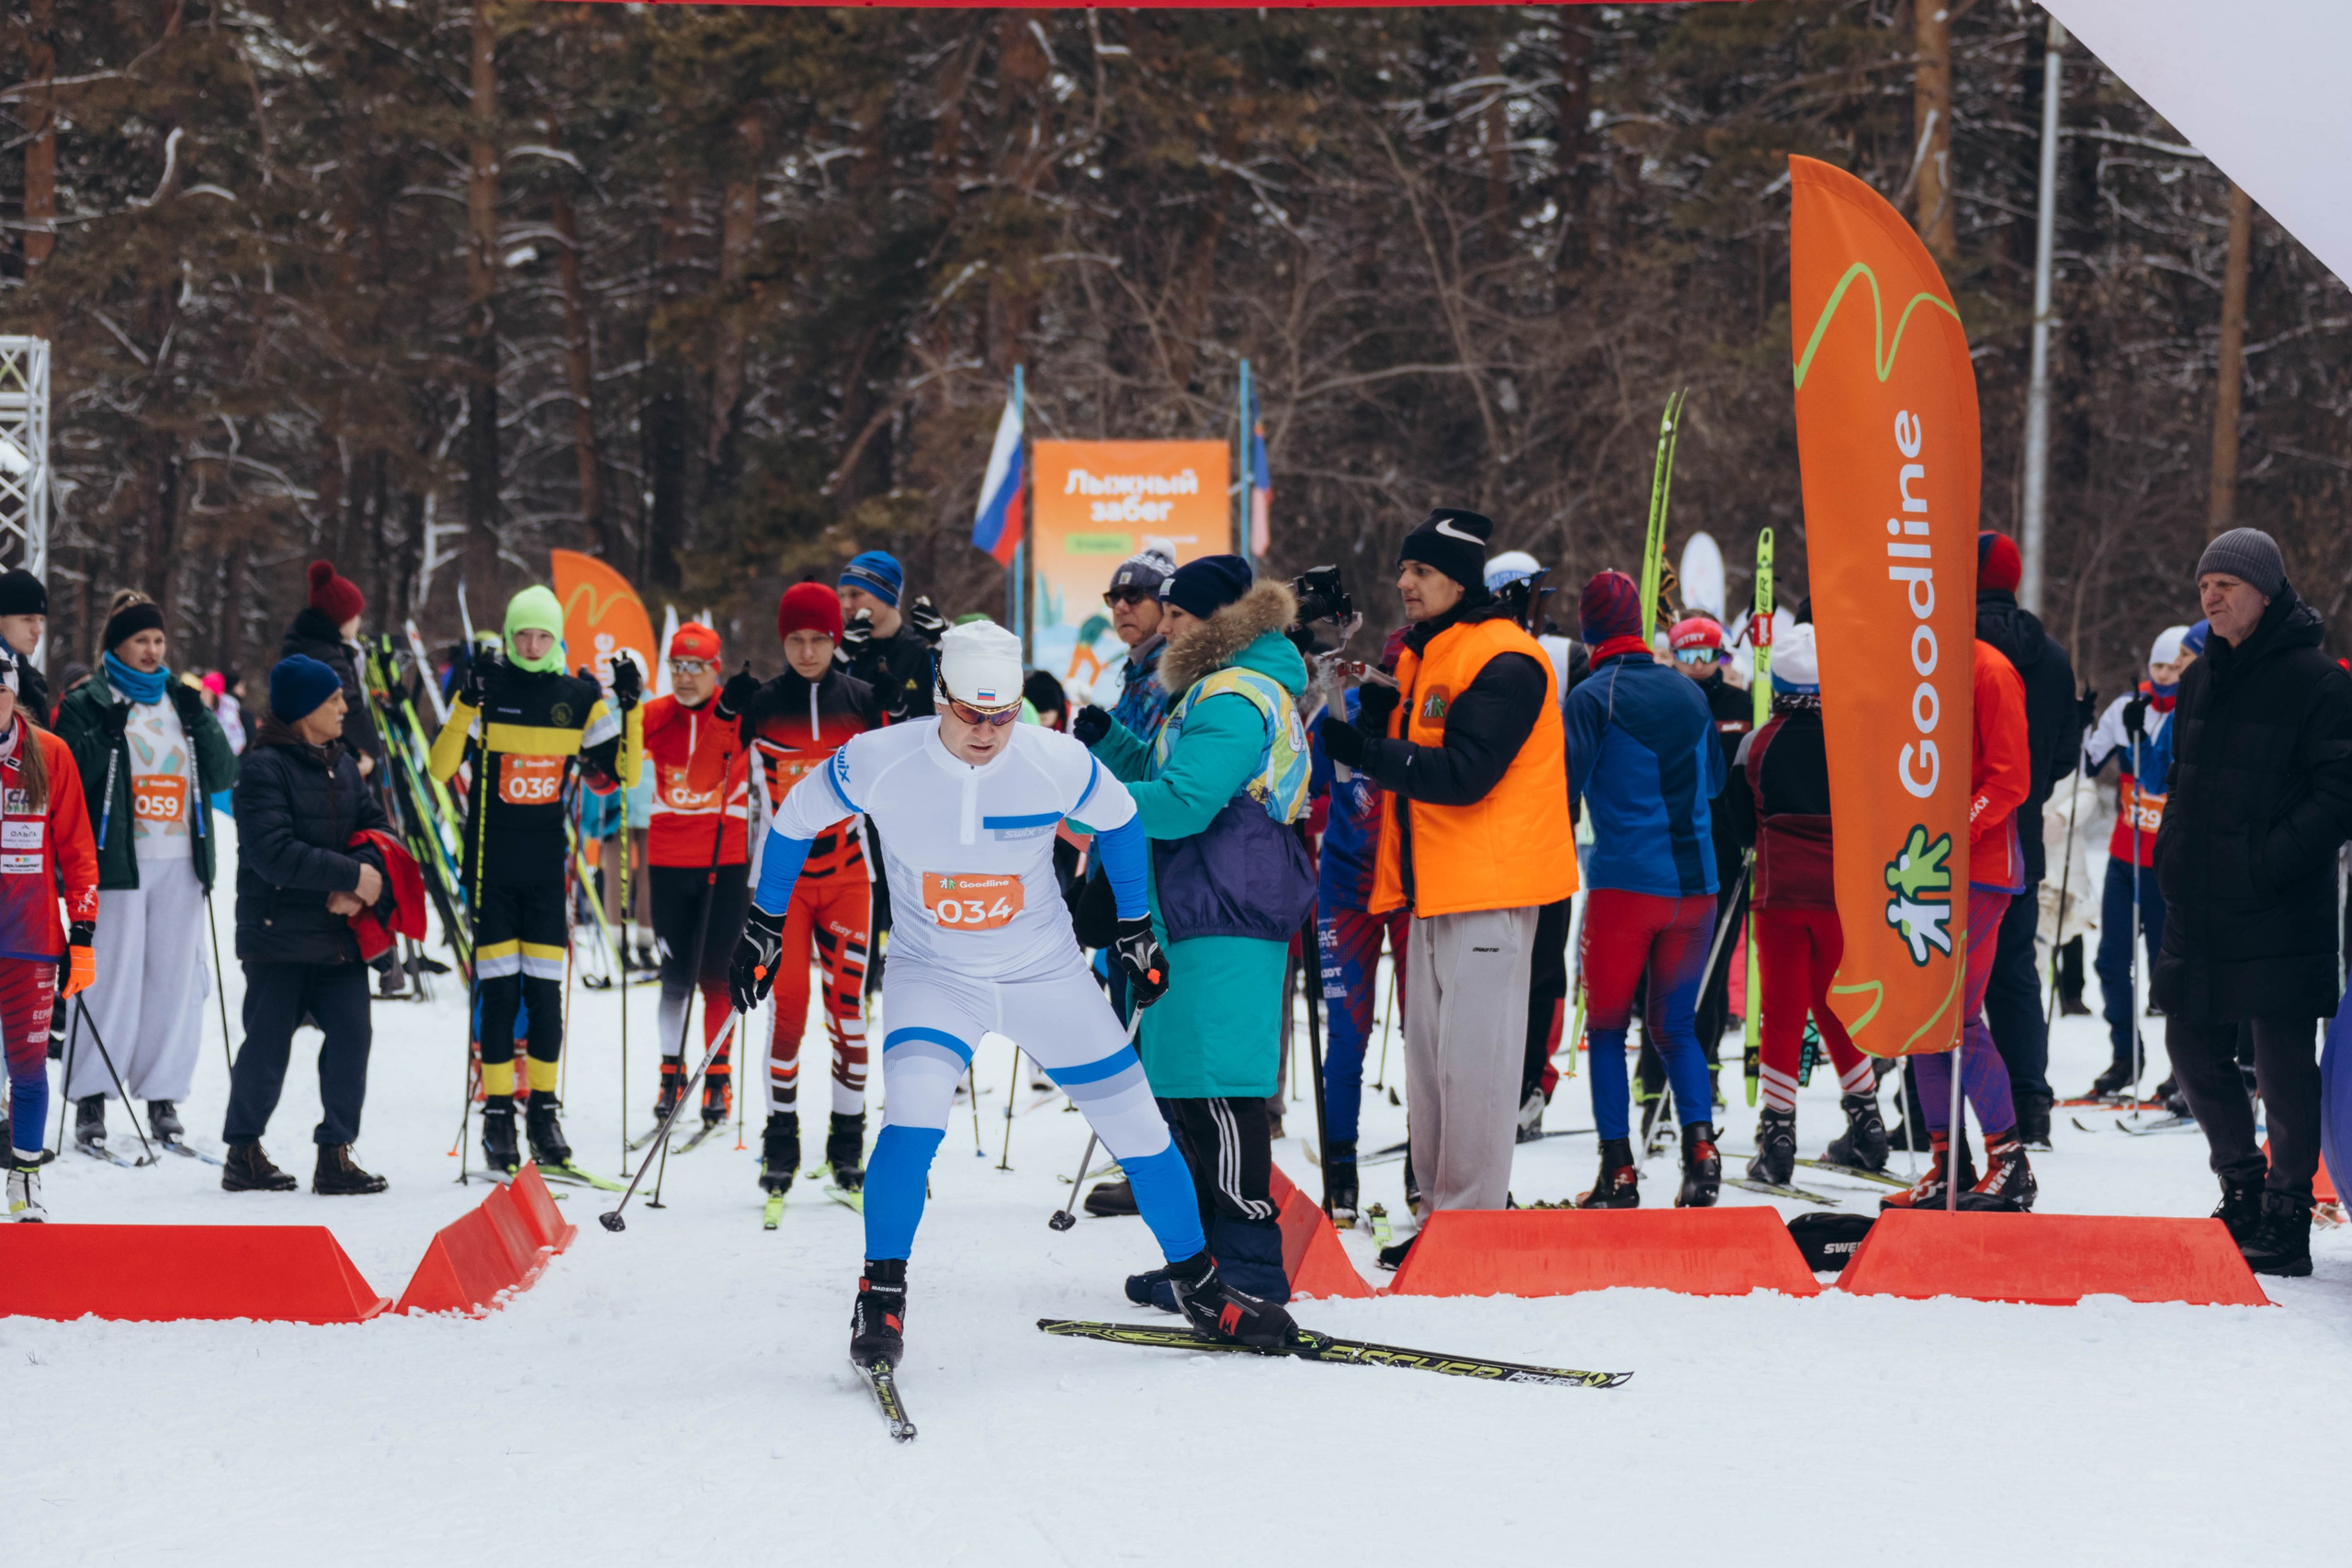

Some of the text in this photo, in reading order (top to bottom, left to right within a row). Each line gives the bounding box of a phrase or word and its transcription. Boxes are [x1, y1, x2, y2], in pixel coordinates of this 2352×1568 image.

[1064, 468, 1198, 494] Лыжный
[1090, 495, 1173, 522] забег
[1886, 409, 1940, 799] Goodline
[509, 776, 556, 798] 036
[134, 795, 178, 817] 059
[2129, 805, 2161, 829] 129
[959, 879, 1010, 888] Goodline
[937, 896, 1013, 924] 034
[1318, 929, 1337, 942] ДС
[871, 1285, 903, 1293] MADSHUS
[1505, 1371, 1580, 1388] FISCHER
